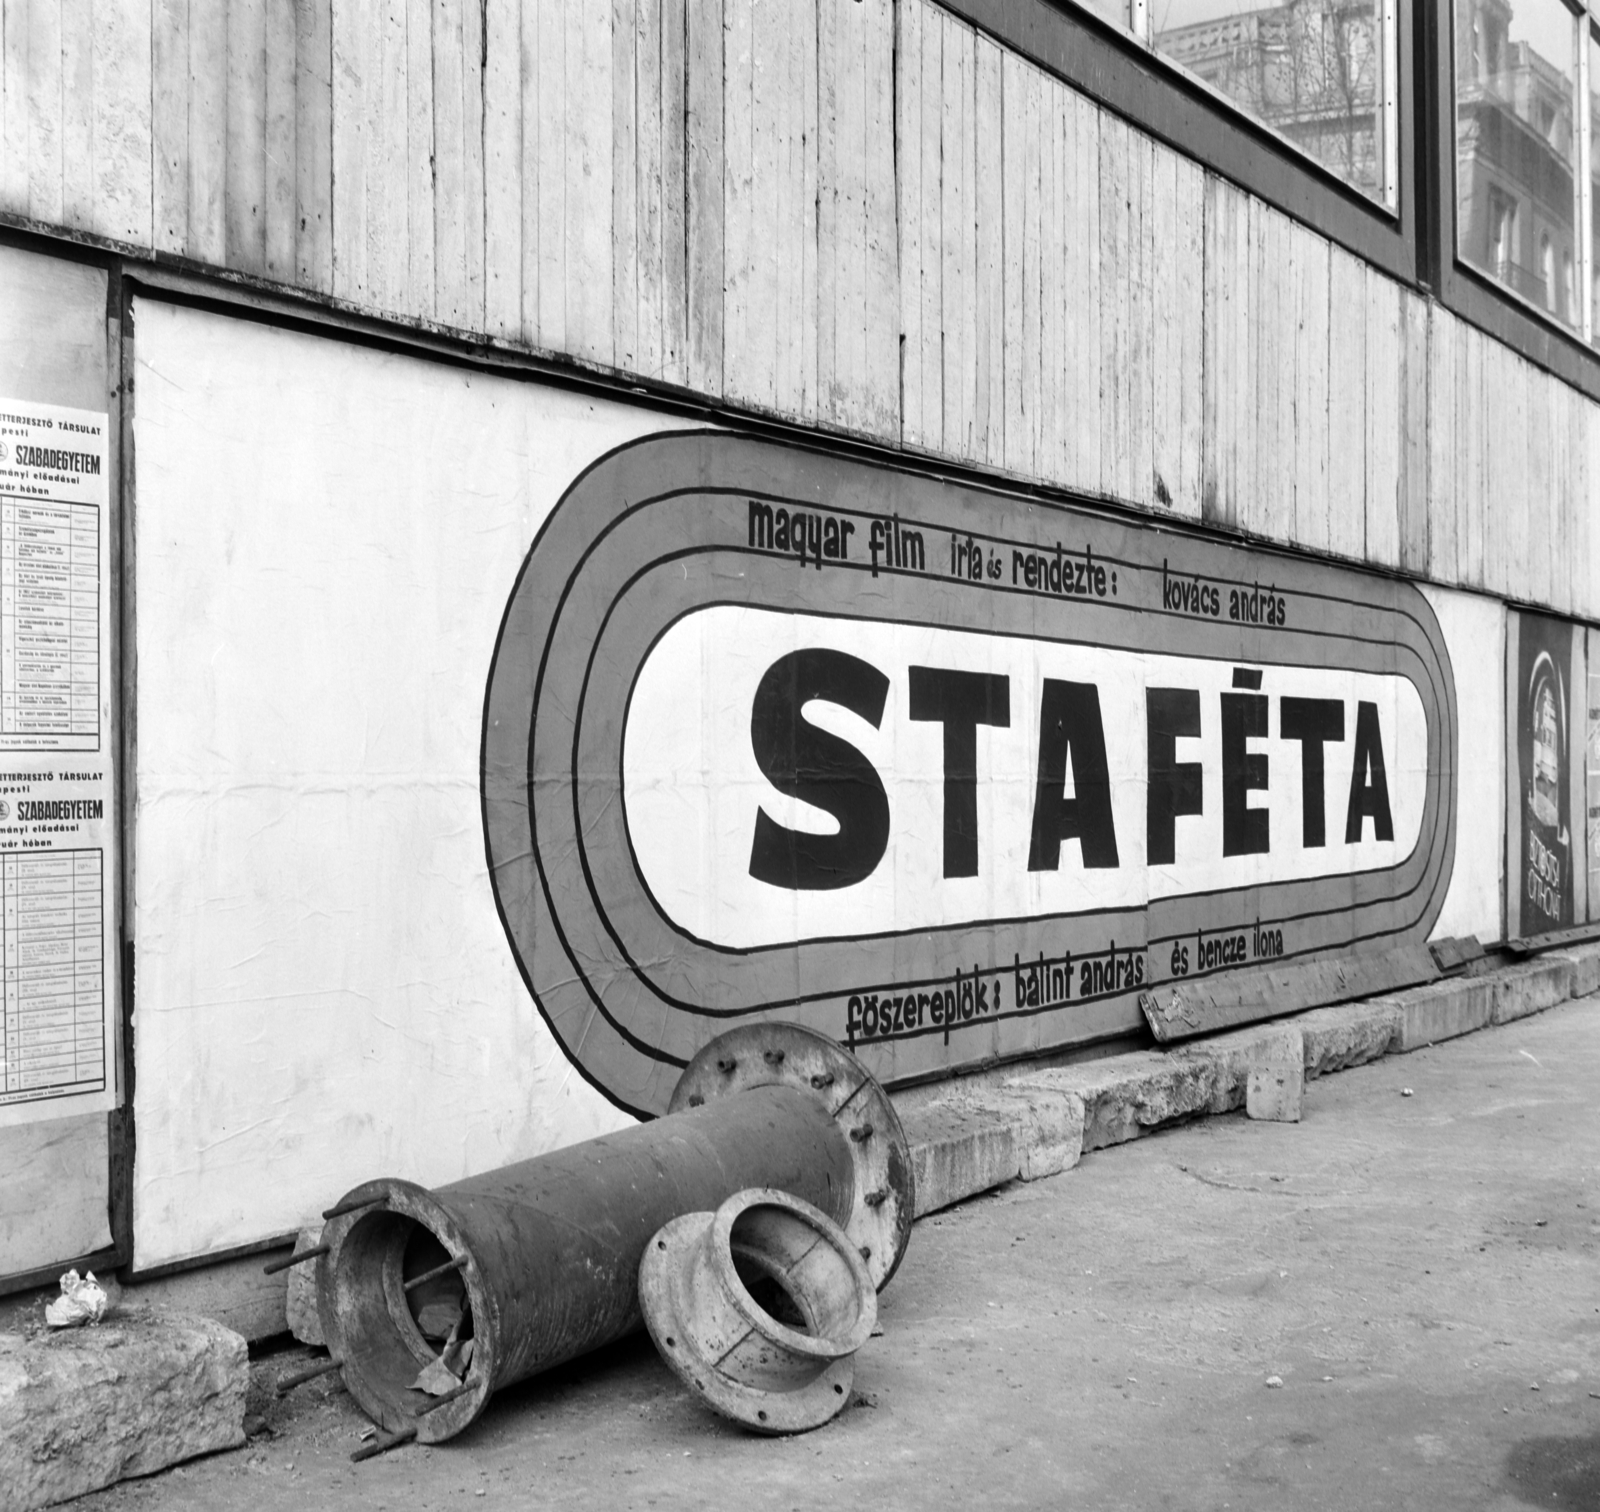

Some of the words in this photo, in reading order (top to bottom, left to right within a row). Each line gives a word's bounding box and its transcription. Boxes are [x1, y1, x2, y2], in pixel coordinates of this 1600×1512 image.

[0, 413, 53, 429] TTERJESZTŐ
[58, 421, 101, 435] TÁRSULAT
[15, 444, 101, 475] SZABADEGYETEM
[20, 484, 49, 495] hóban
[748, 500, 855, 571] magyar
[868, 512, 926, 579] film
[986, 547, 1002, 580] és
[1163, 557, 1220, 617] kovács
[1229, 580, 1286, 626] andrás
[59, 771, 104, 781] TÁRSULAT
[748, 647, 1394, 891] STAFÉTA
[0, 785, 30, 795] pesti
[17, 799, 104, 821] SZABADEGYETEM
[0, 839, 18, 849] uár
[22, 838, 52, 848] hóban
[1015, 950, 1075, 1009] bálint
[1080, 939, 1144, 997] andrás
[1171, 940, 1189, 976] és
[1198, 927, 1247, 971] bencze
[1253, 916, 1284, 957] ilona
